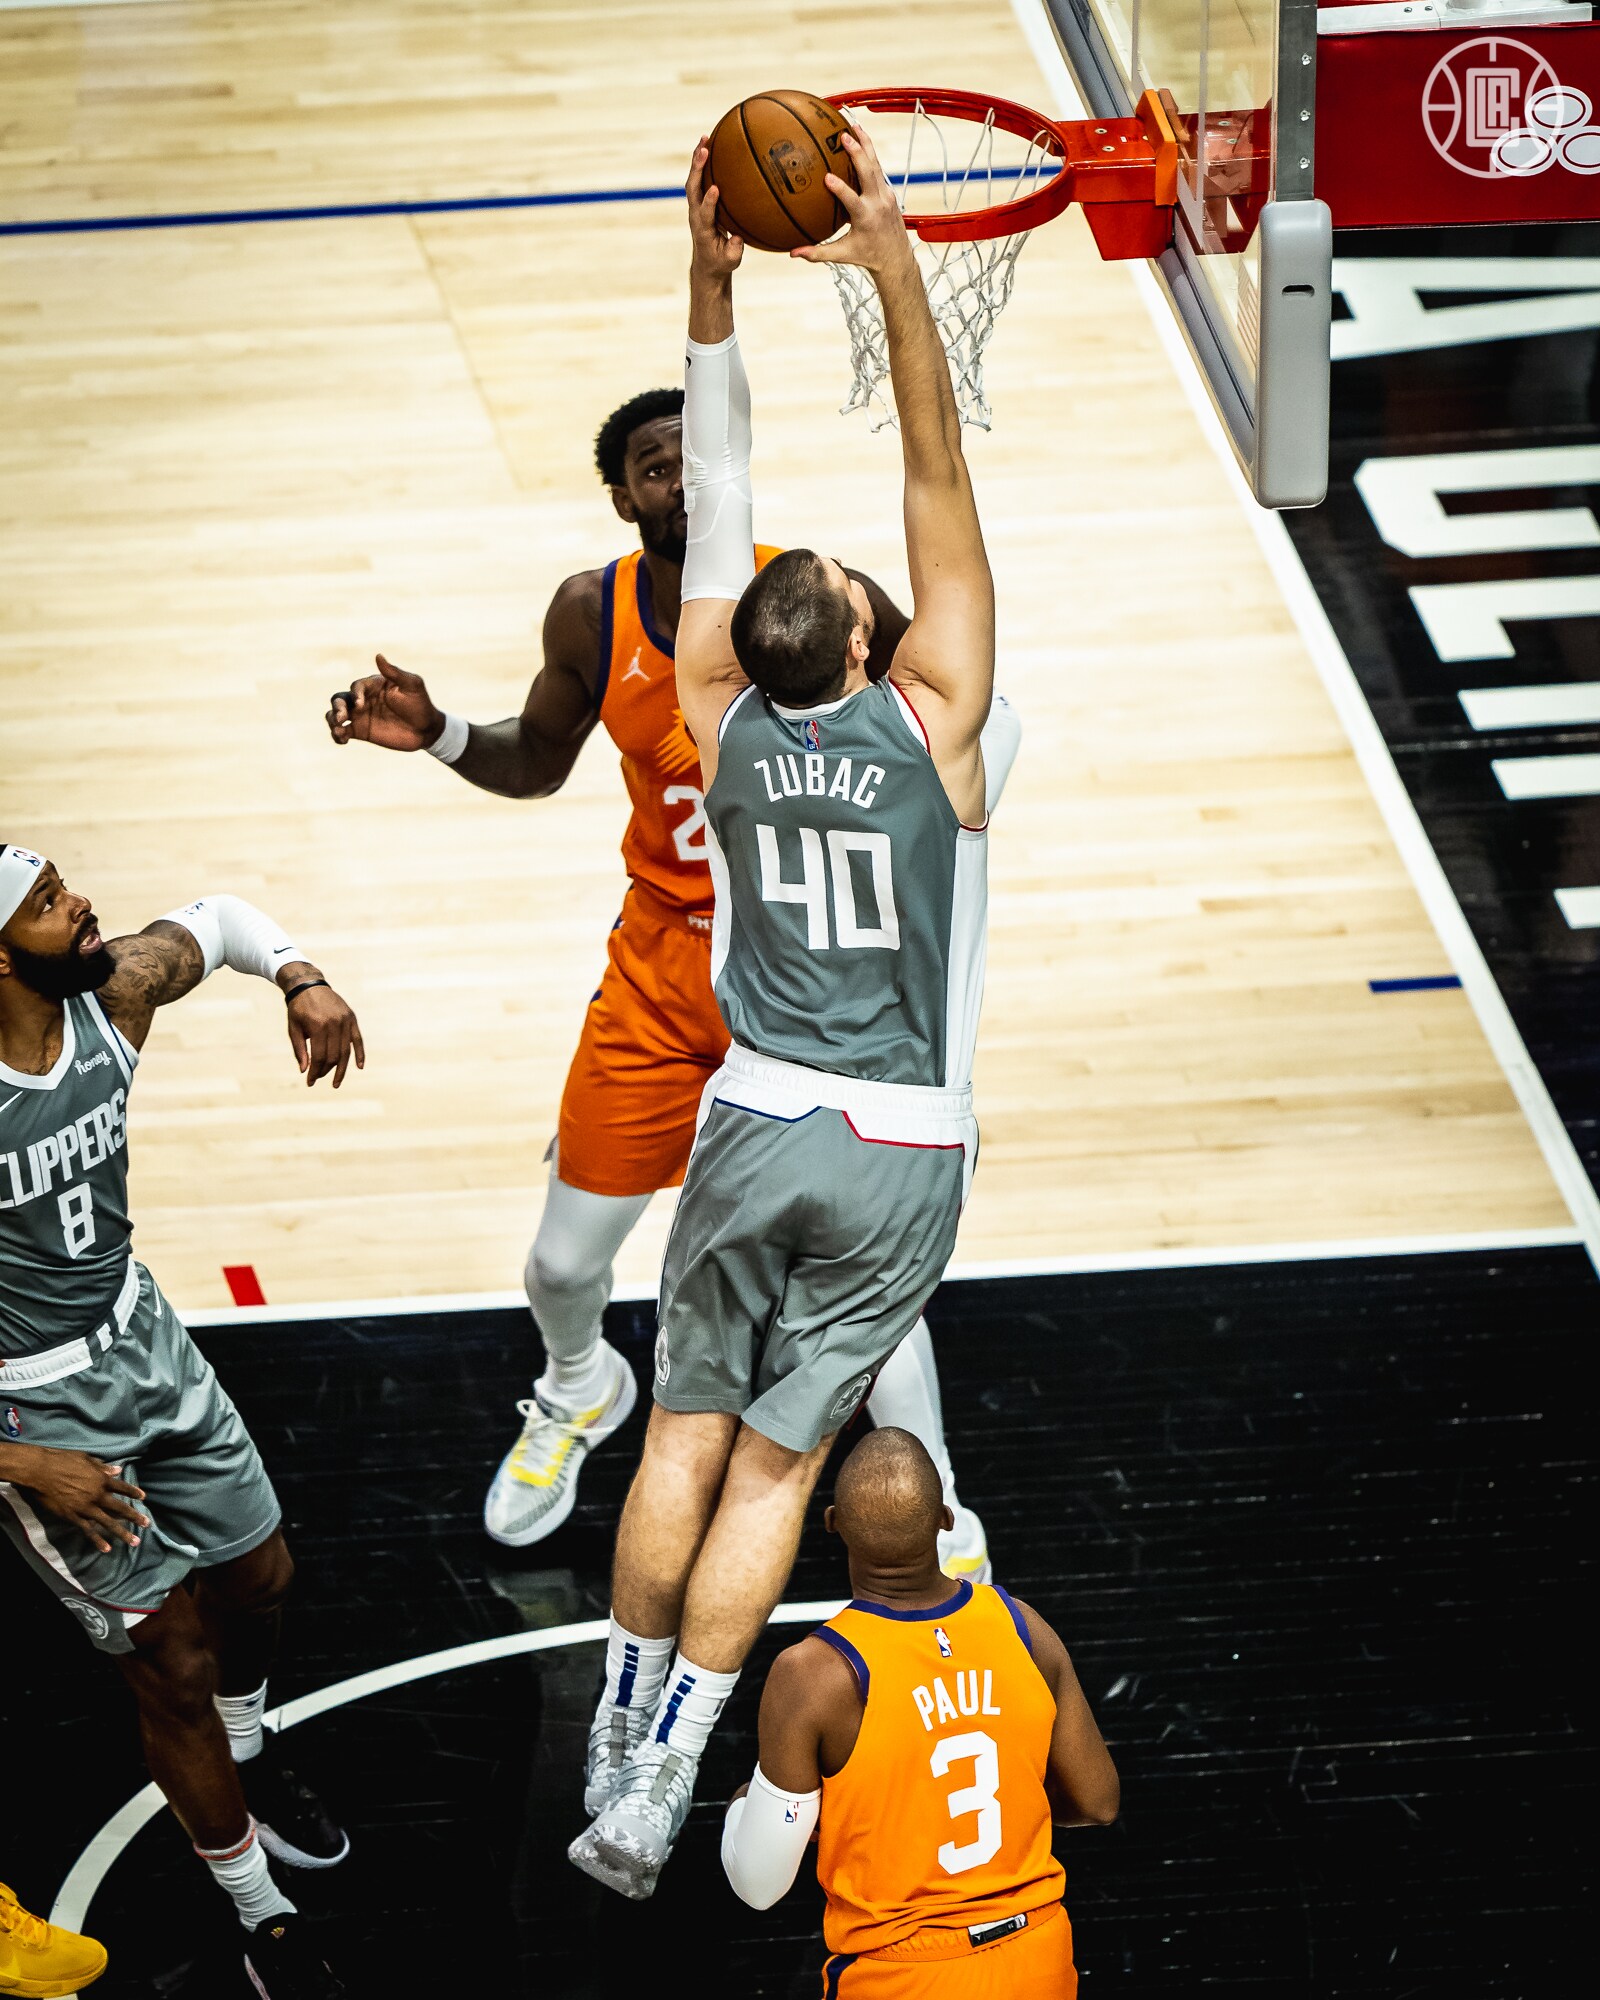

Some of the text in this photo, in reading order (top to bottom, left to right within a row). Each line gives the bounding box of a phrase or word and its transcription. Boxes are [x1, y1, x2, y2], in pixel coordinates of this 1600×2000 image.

[753, 753, 886, 809] ZUBAC
[756, 824, 900, 951] 40
[74, 1050, 112, 1075] honey
[57, 1182, 96, 1259] 8
[911, 1669, 1001, 1731] PAUL
[929, 1730, 1002, 1875] 3
